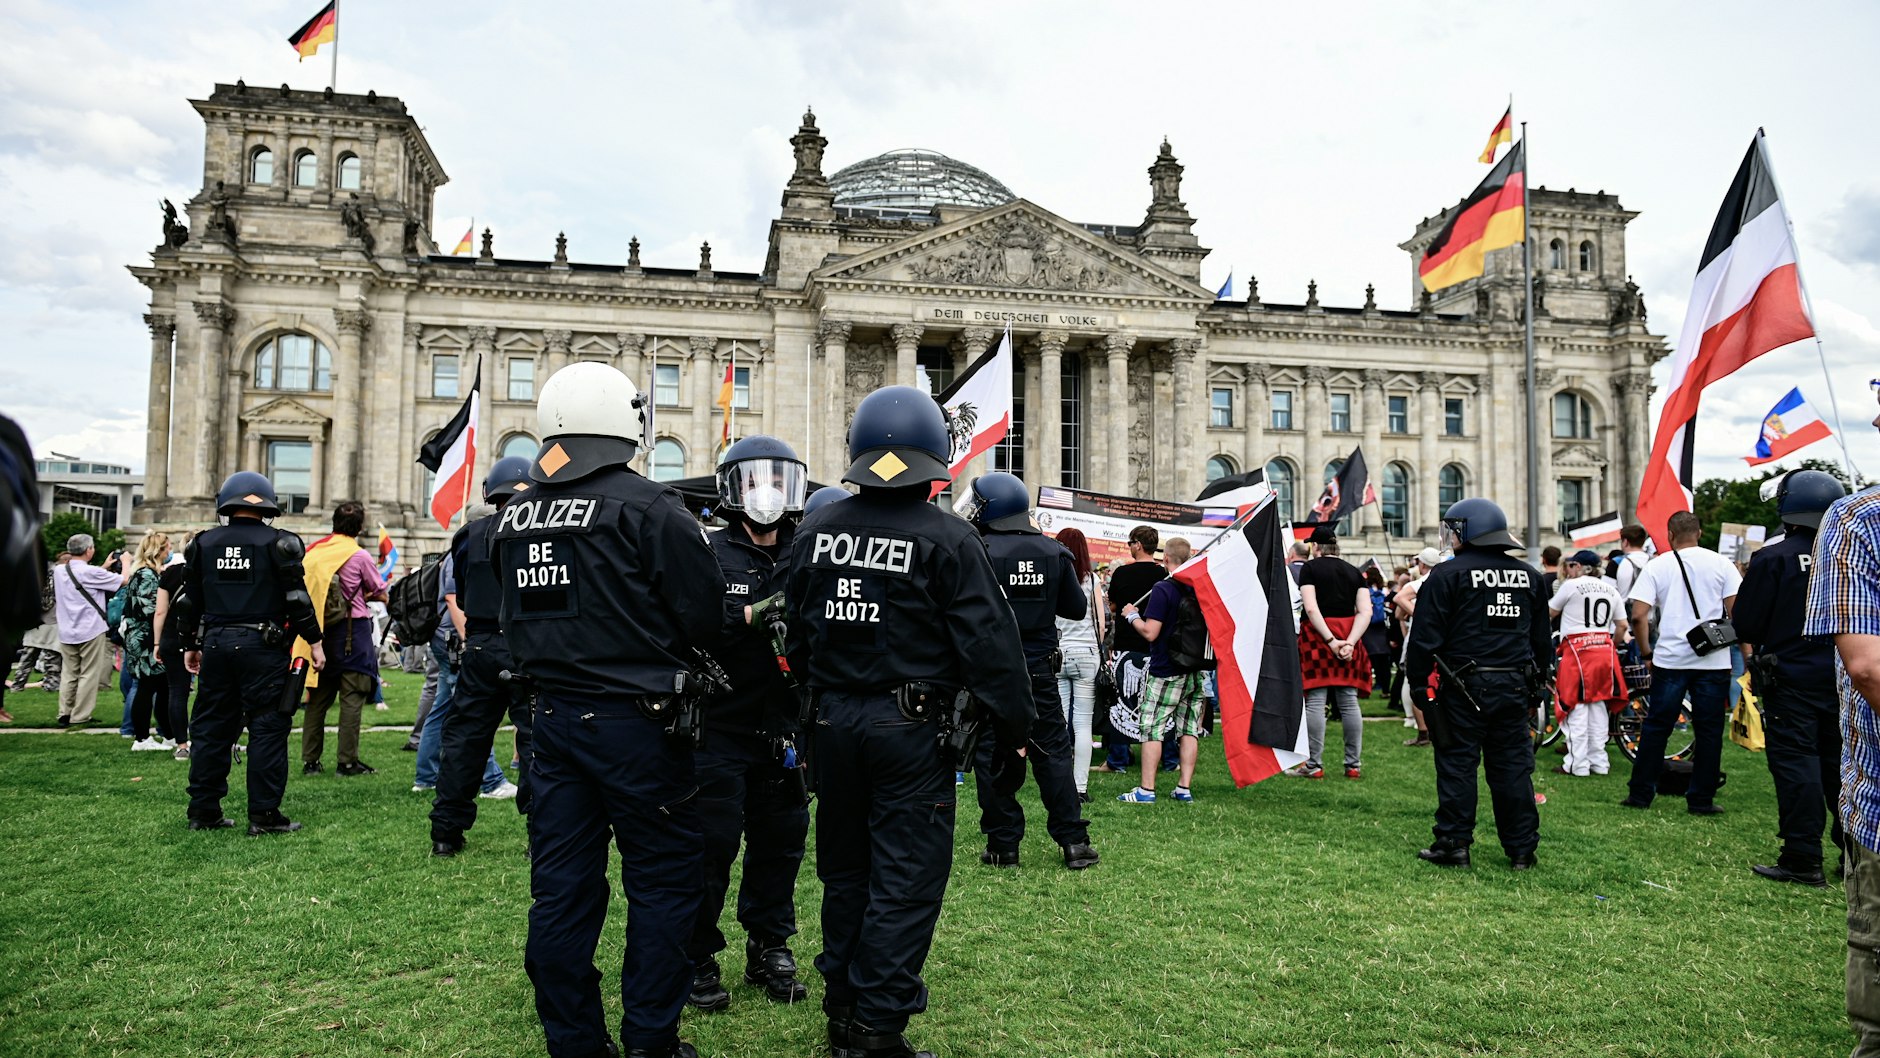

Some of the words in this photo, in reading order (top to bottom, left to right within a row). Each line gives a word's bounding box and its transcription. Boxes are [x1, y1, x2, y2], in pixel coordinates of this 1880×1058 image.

[934, 308, 963, 319] DEM
[974, 311, 1049, 323] DEUTSCHEN
[1059, 315, 1097, 326] VOLKE
[1077, 493, 1092, 502] Trump
[497, 499, 597, 533] POLIZEI
[226, 547, 241, 558] BE
[528, 541, 554, 564] BE
[811, 532, 914, 574] POLIZEI
[217, 558, 250, 569] D1214
[1018, 561, 1034, 573] BE
[516, 562, 571, 588] D1071
[1010, 573, 1044, 585] D1218
[1471, 569, 1531, 589] POLIZEI
[725, 583, 749, 595] LIZEI
[836, 578, 862, 599] BE
[1496, 592, 1513, 605] BE
[824, 600, 881, 623] D1072
[1486, 604, 1521, 618] D1213
[1584, 596, 1611, 628] 10
